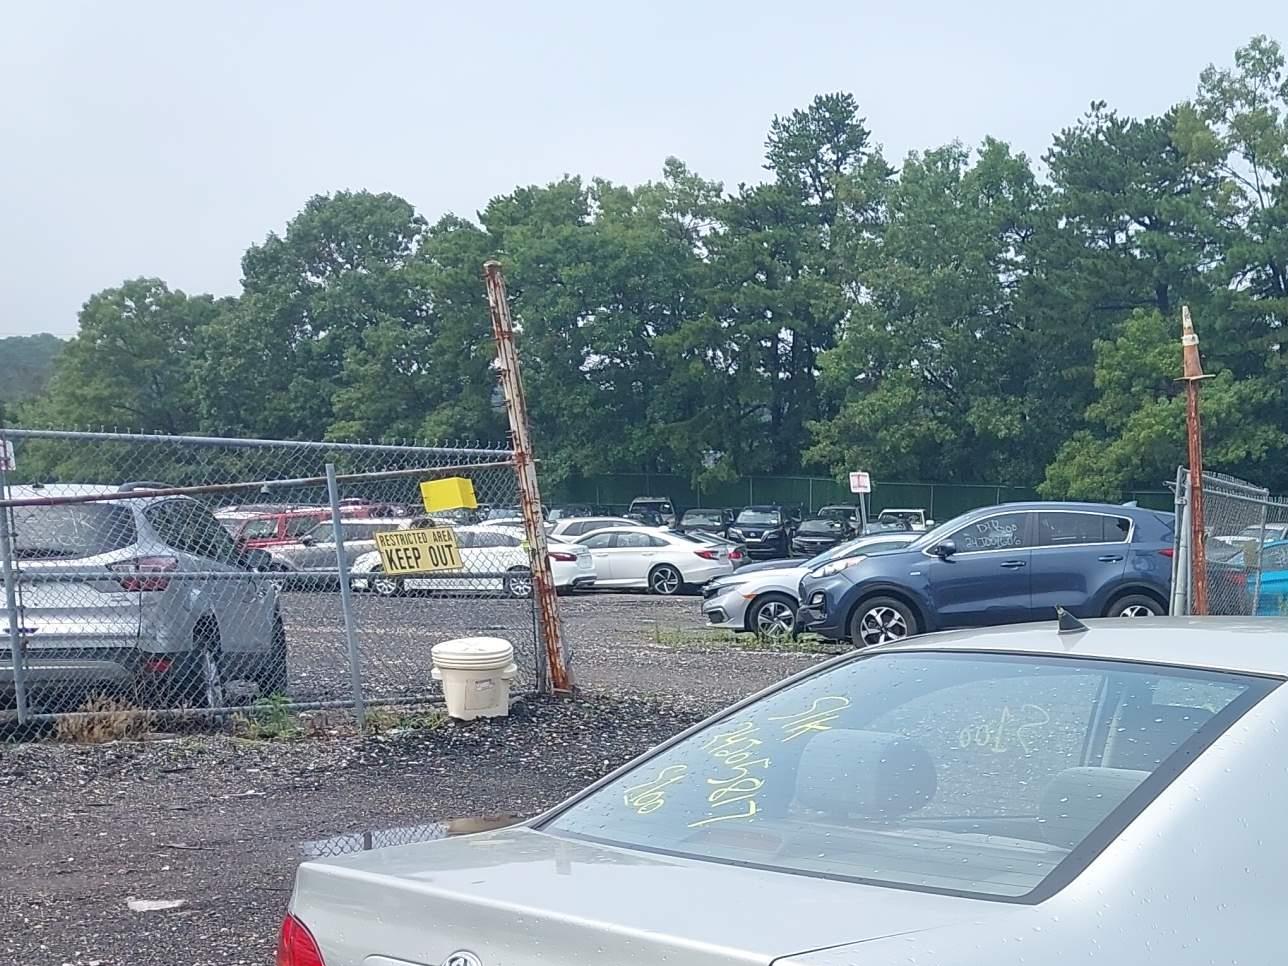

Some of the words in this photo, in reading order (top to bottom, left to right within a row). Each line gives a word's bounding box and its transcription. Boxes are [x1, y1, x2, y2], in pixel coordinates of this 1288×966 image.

[378, 532, 428, 547] RESTRICTED
[432, 529, 454, 543] AREA
[385, 547, 422, 571] KEEP
[428, 544, 455, 567] OUT
